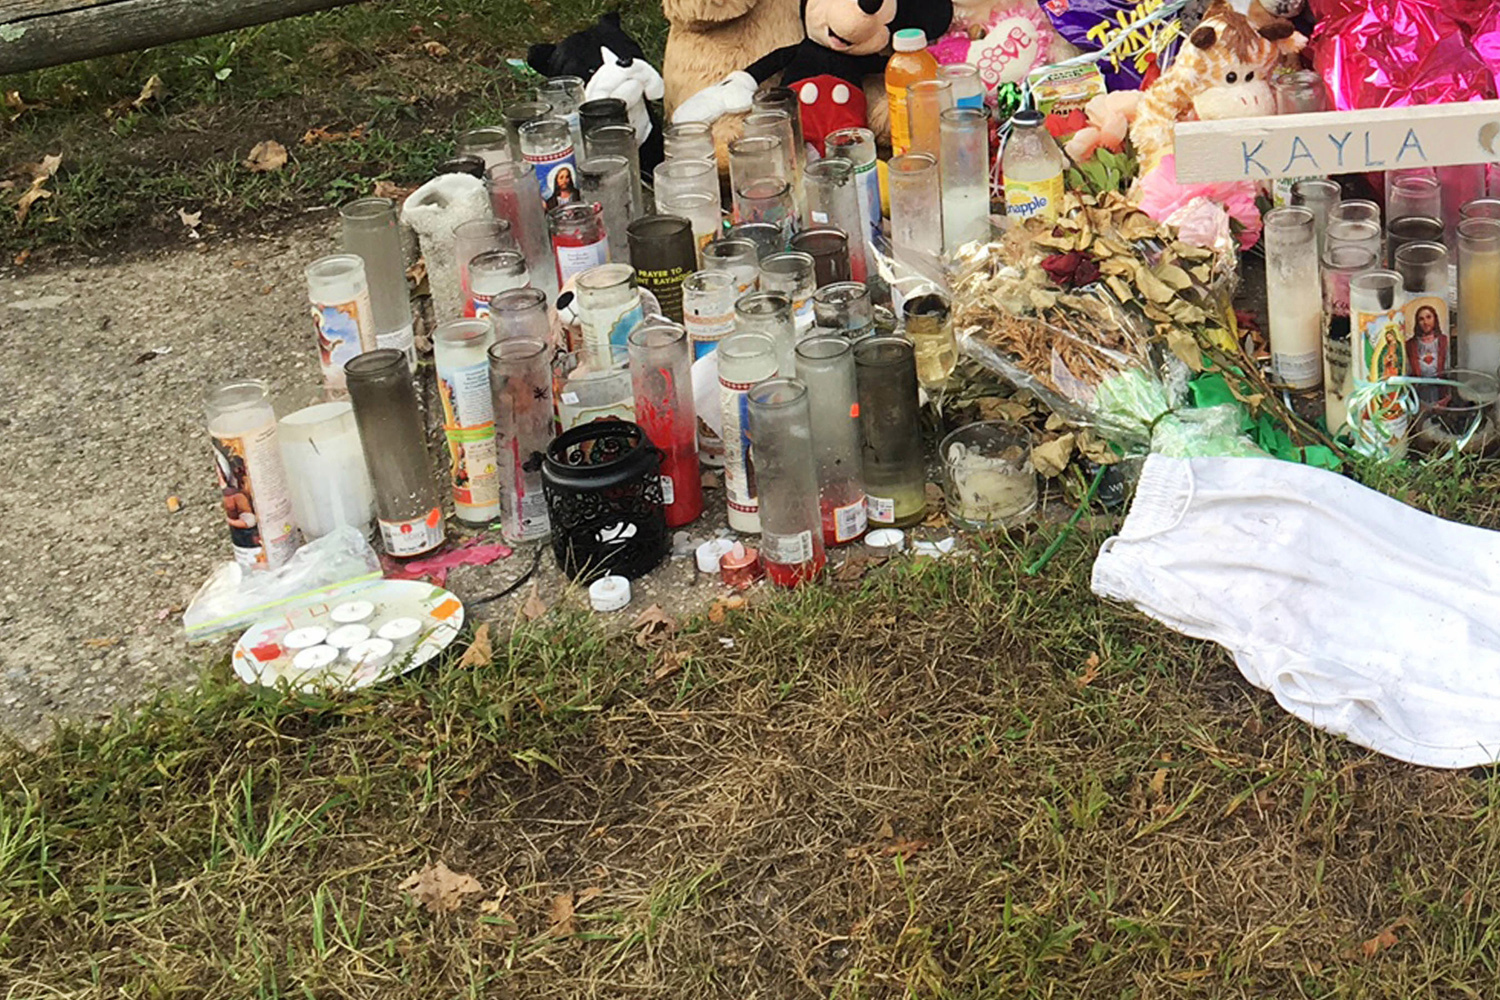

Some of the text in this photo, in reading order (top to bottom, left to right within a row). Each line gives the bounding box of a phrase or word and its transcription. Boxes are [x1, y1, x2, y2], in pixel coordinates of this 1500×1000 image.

[1241, 127, 1428, 176] KAYLA
[1007, 196, 1047, 216] napple
[638, 266, 683, 278] PRAYER TO
